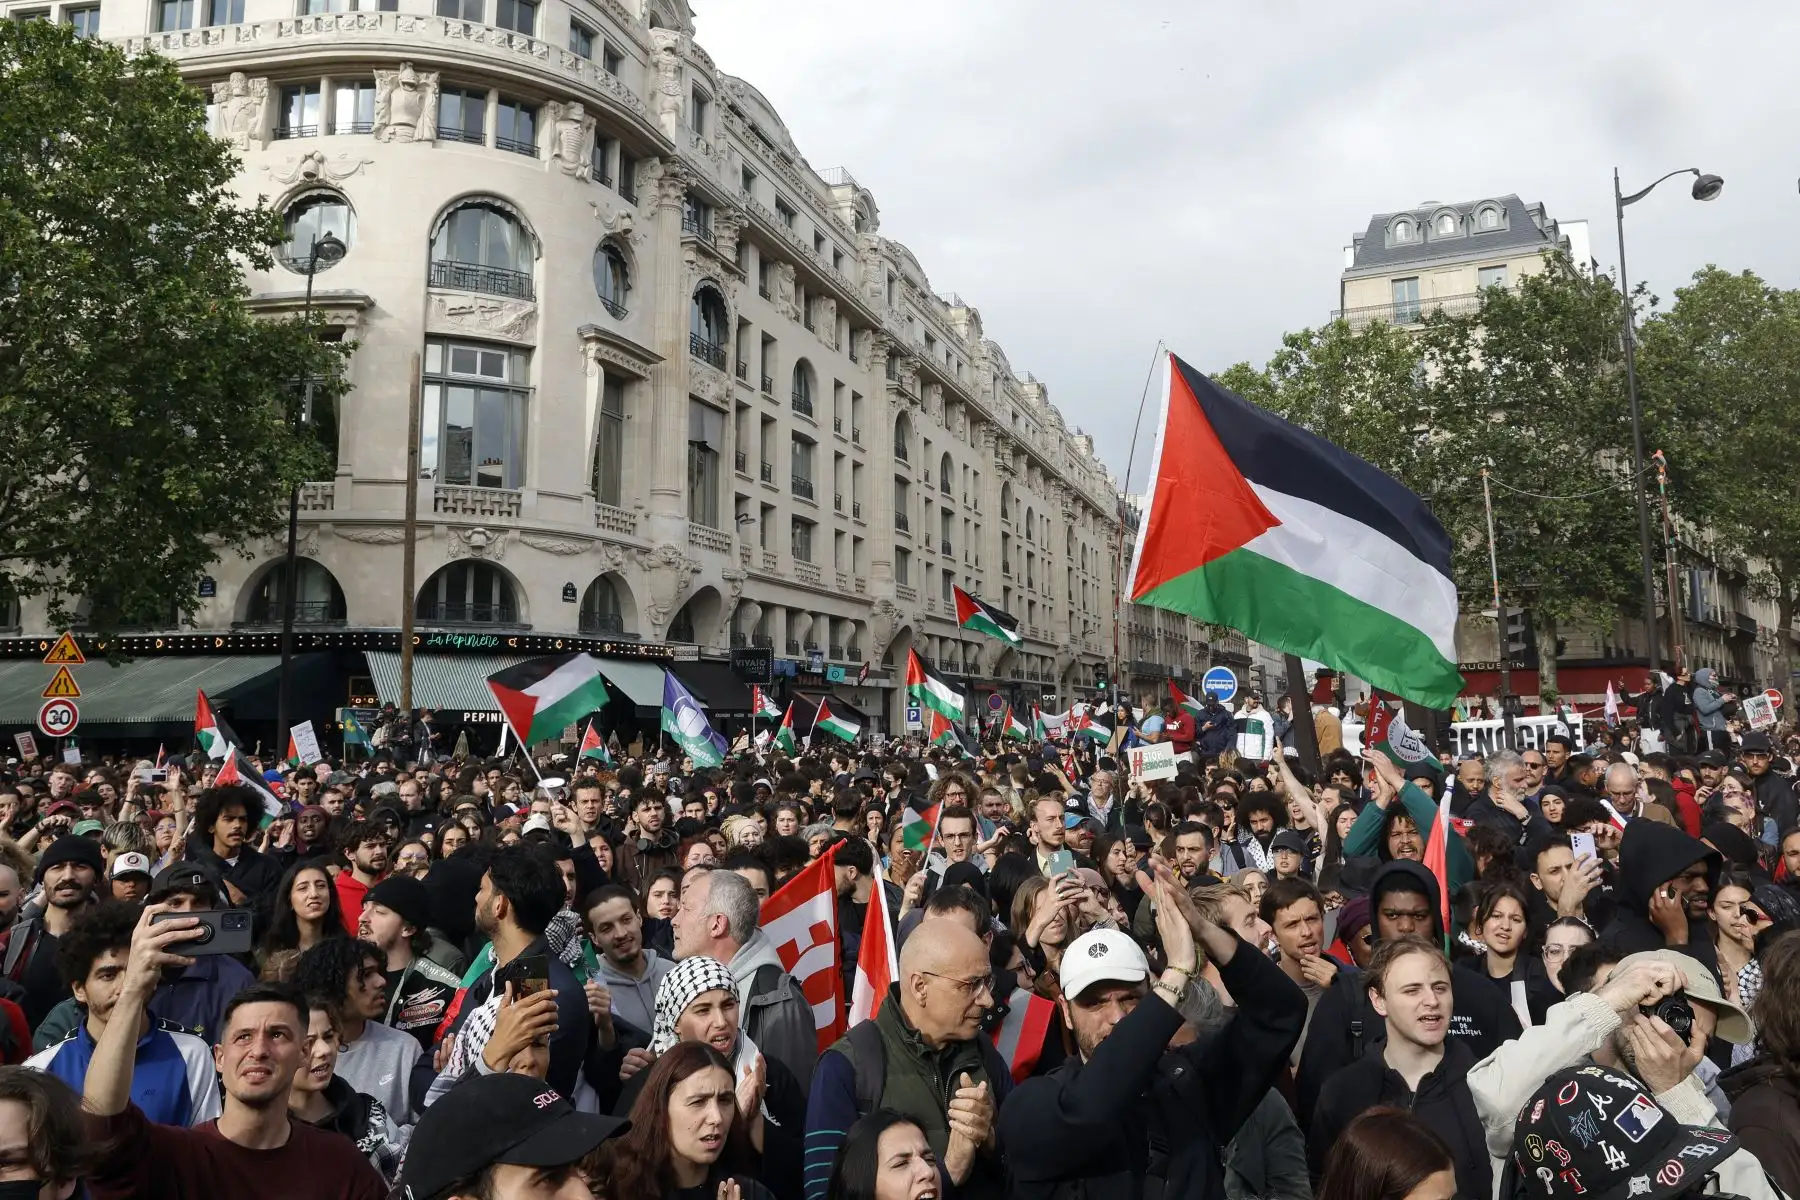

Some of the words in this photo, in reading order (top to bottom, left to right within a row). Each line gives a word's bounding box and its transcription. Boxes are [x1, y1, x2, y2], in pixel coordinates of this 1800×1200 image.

[427, 633, 443, 645] La
[1460, 662, 1525, 670] AUGUSIN
[48, 709, 71, 725] 30
[910, 711, 917, 721] P
[1369, 700, 1385, 750] AFPS
[1143, 751, 1162, 762] STOP
[1597, 1139, 1630, 1172] LA
[1535, 1166, 1554, 1195] P
